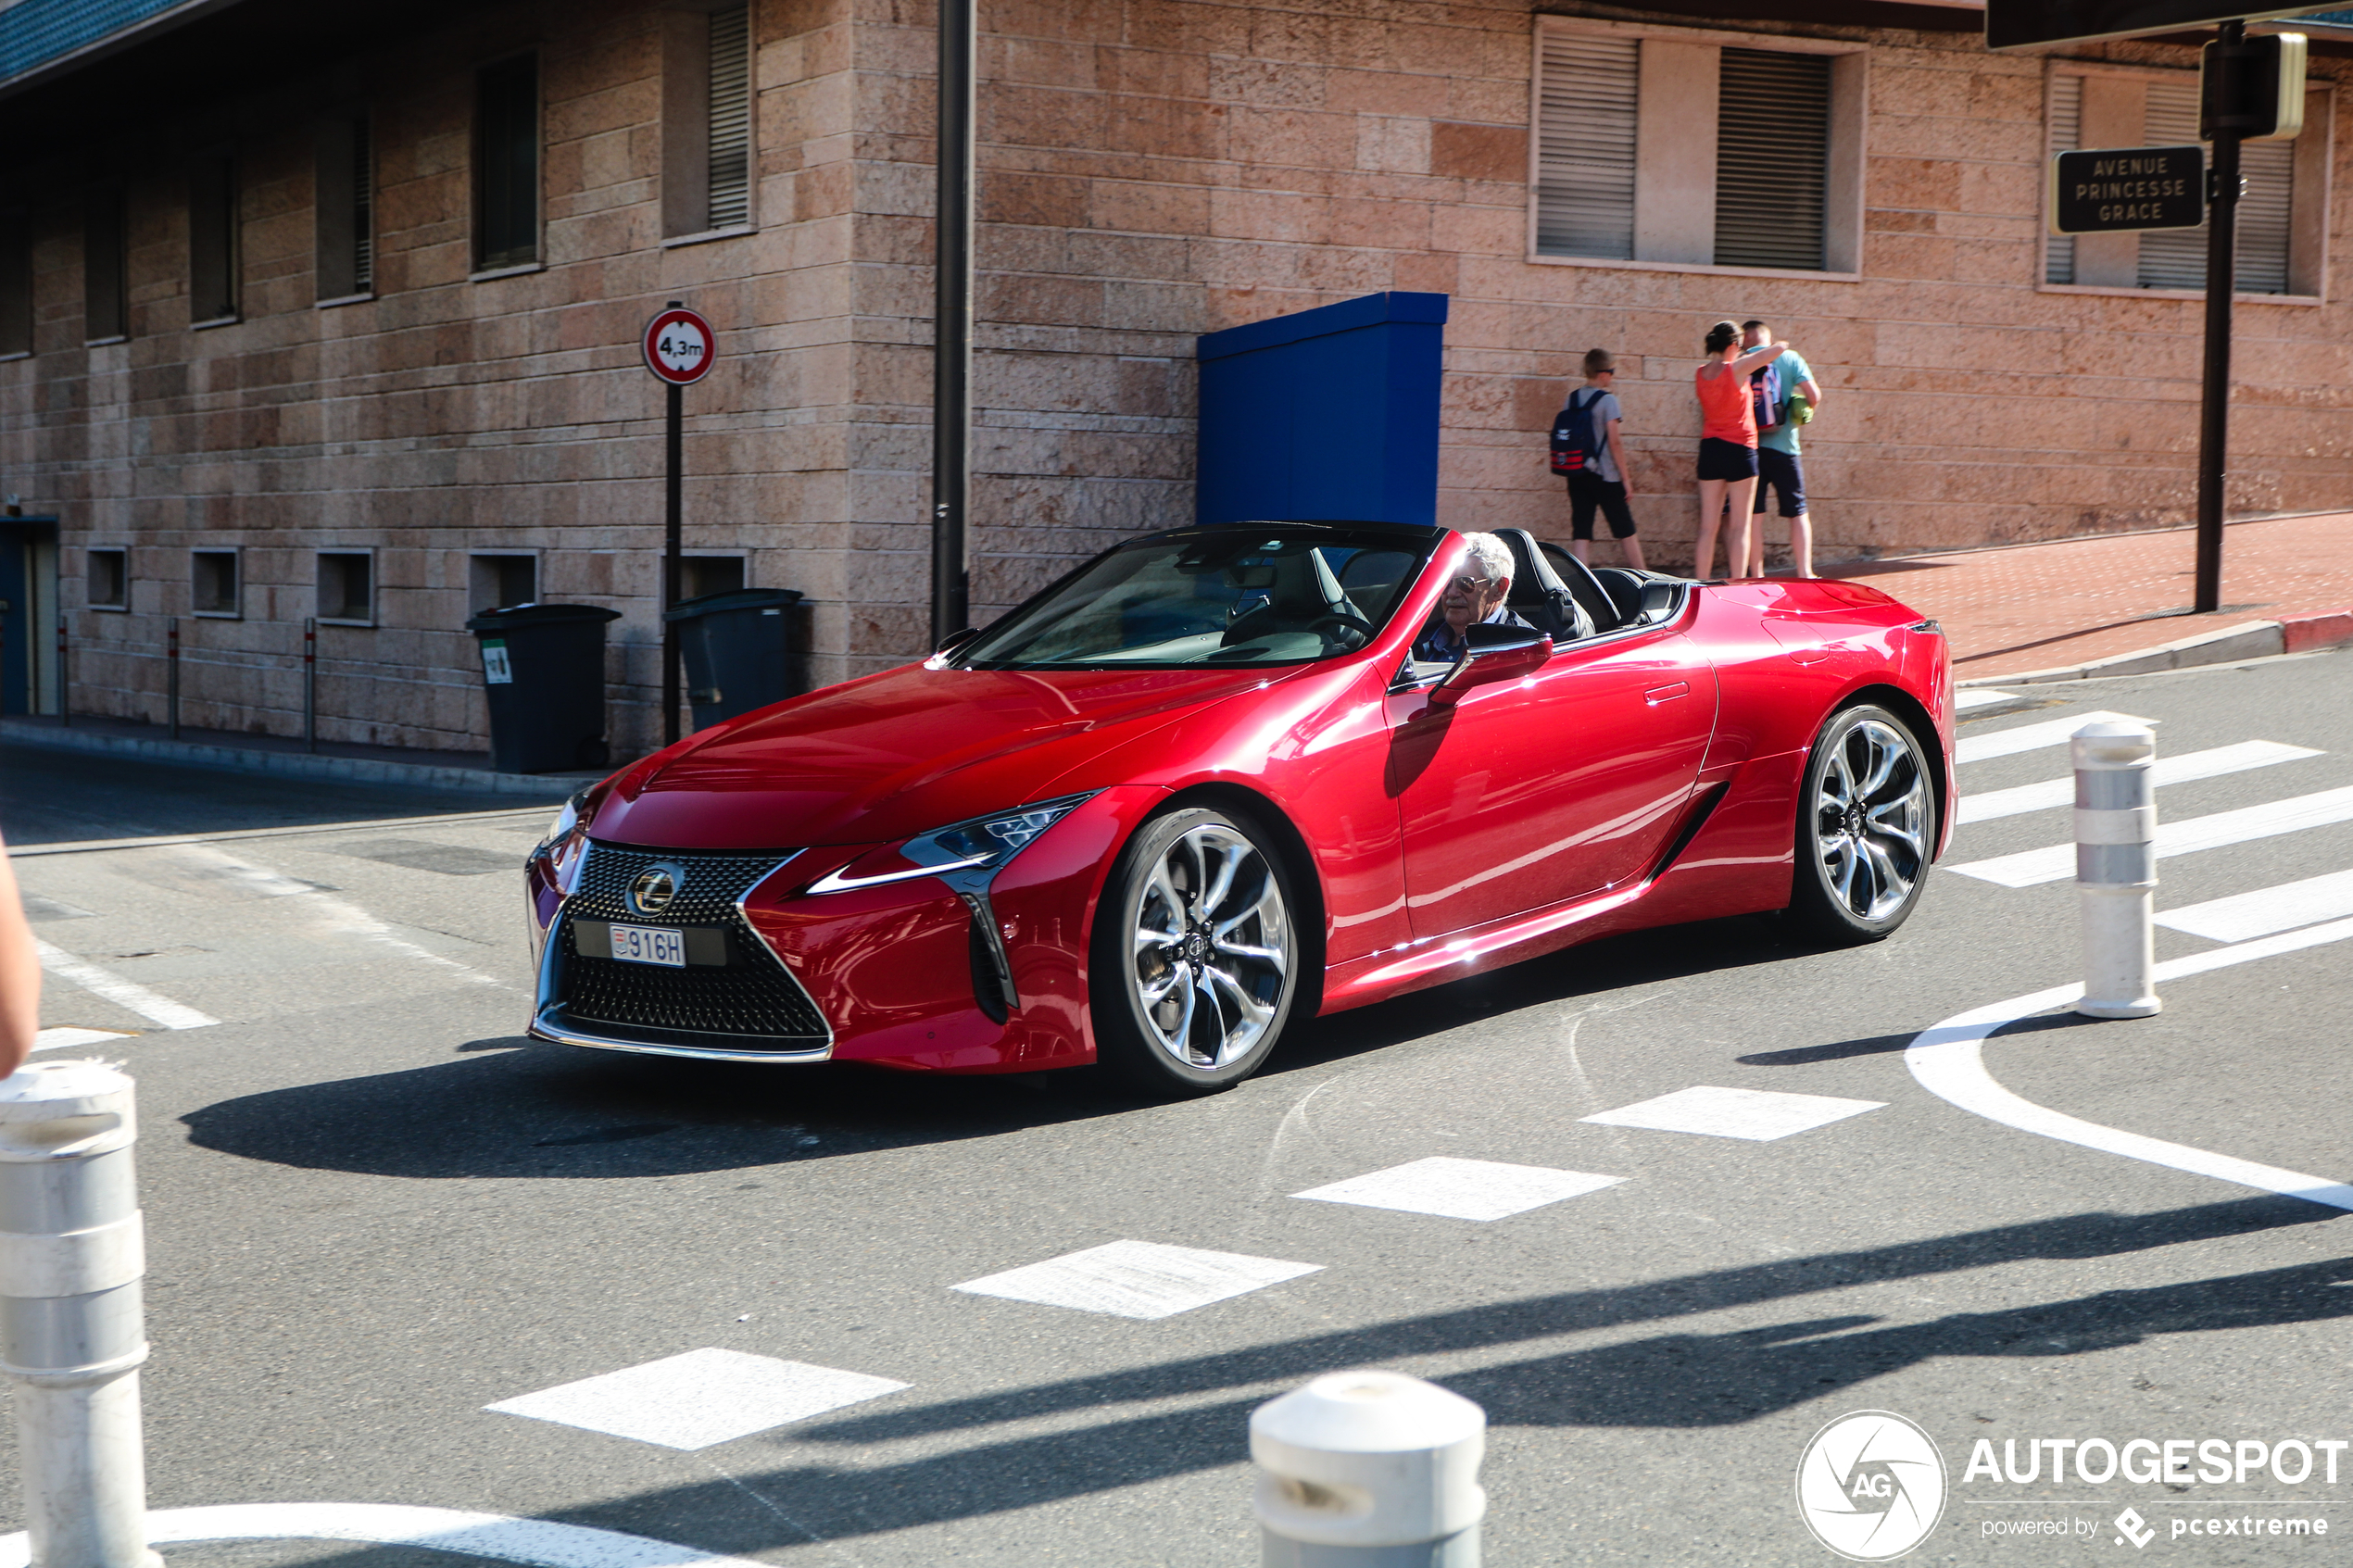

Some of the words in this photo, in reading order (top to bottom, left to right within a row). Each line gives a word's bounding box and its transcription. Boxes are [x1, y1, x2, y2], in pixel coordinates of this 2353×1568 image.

[2094, 157, 2168, 176] AVENUE
[2076, 180, 2185, 200] PRINCESSE
[2099, 203, 2163, 221] GRACE
[628, 931, 681, 962] 916H
